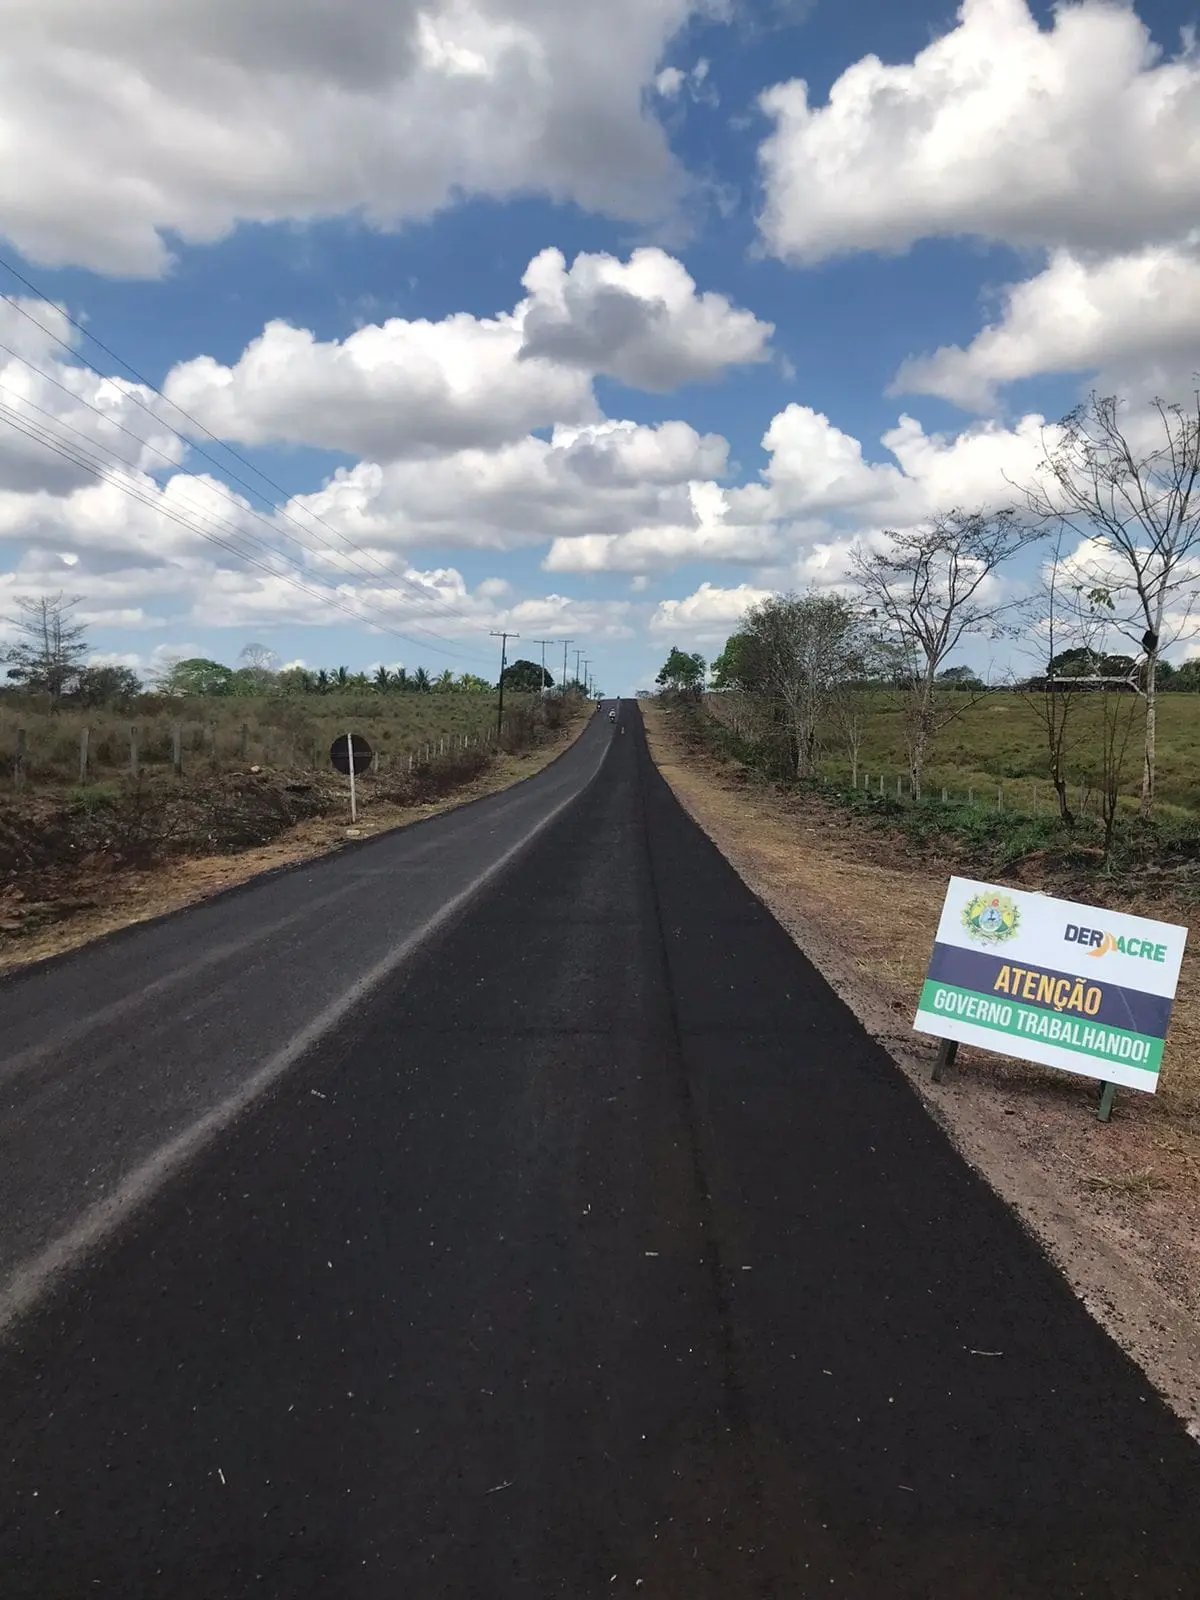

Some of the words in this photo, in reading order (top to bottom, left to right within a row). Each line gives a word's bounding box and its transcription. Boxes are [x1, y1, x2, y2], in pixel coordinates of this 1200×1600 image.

[993, 965, 1102, 1015] ATENÇÃO
[933, 989, 1012, 1026] GOVERNO
[1016, 1010, 1151, 1063] TRABALHANDO!
